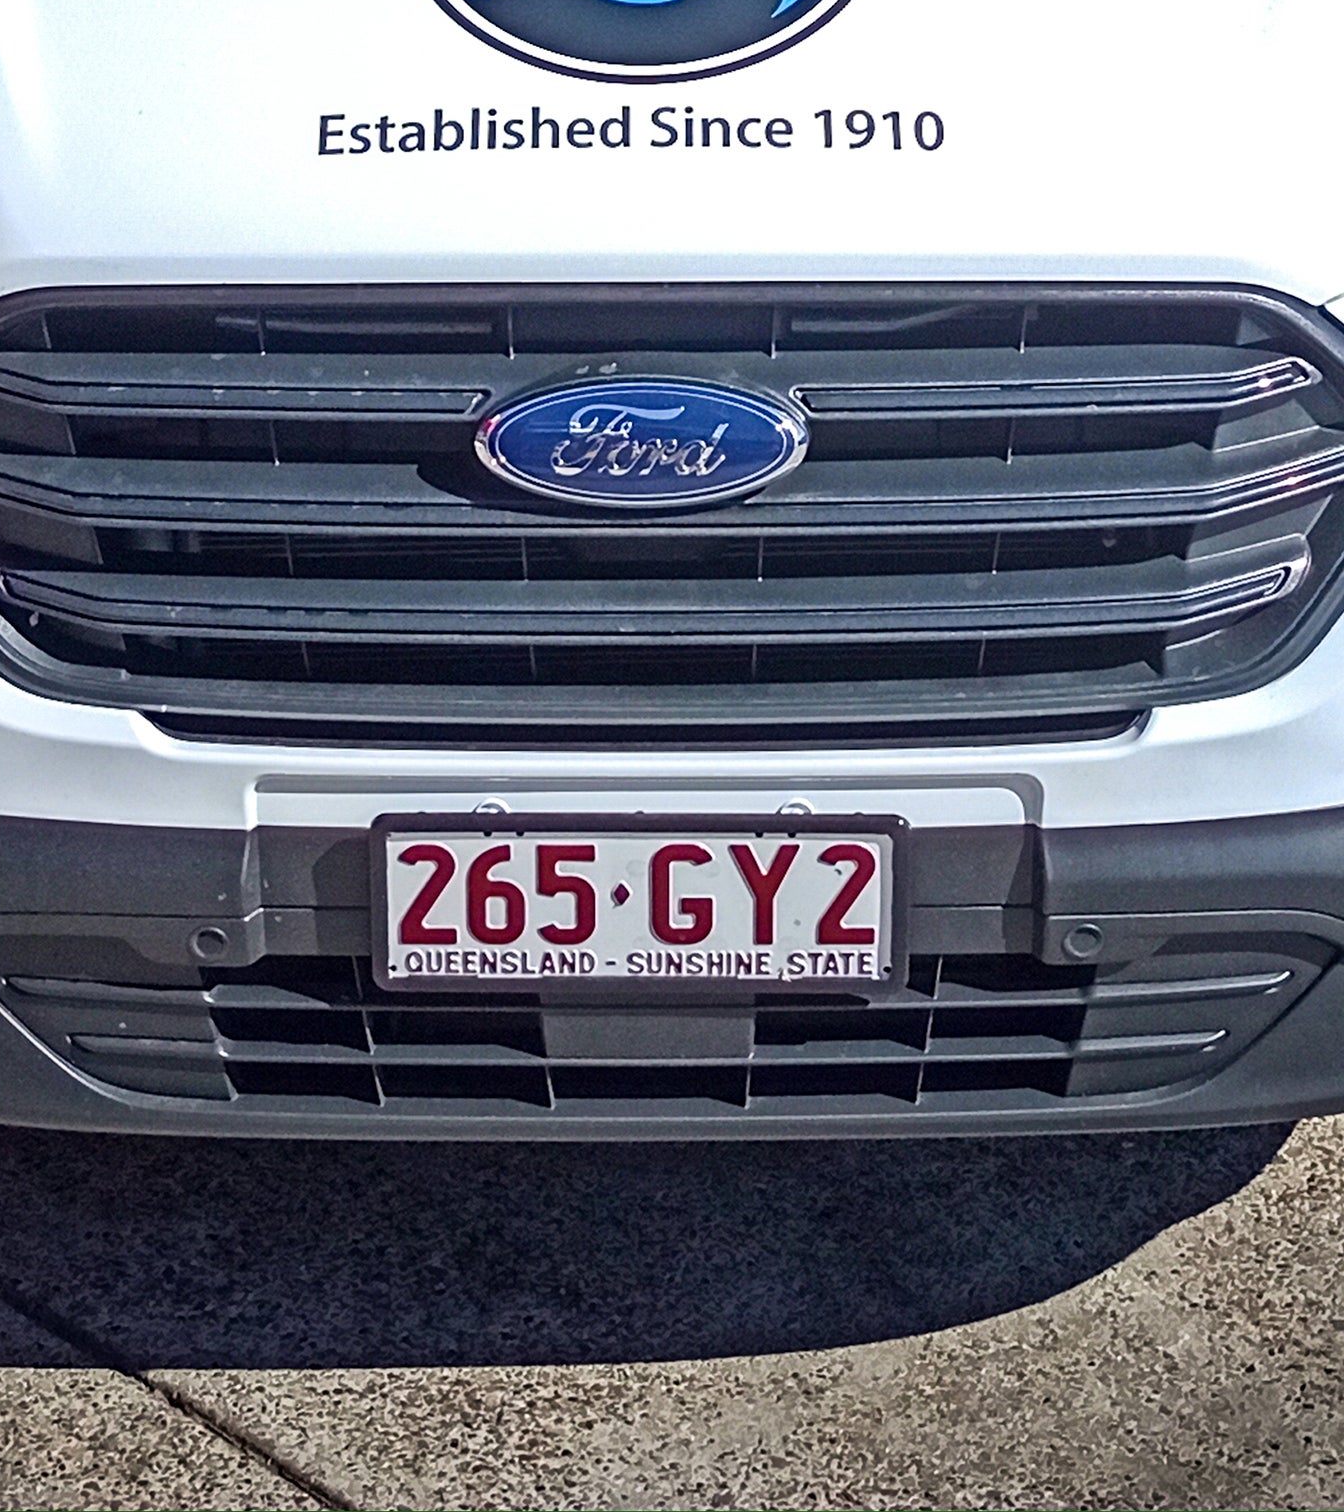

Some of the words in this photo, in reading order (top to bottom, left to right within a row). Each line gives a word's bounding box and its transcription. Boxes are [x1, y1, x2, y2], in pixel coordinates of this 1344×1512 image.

[318, 105, 631, 156] Established
[650, 106, 793, 150] Since
[814, 109, 944, 151] 1910
[551, 403, 728, 476] Ford
[405, 951, 596, 974] QUEENSLAND
[627, 951, 770, 974] SUNSHINE
[786, 951, 873, 974] STATE
